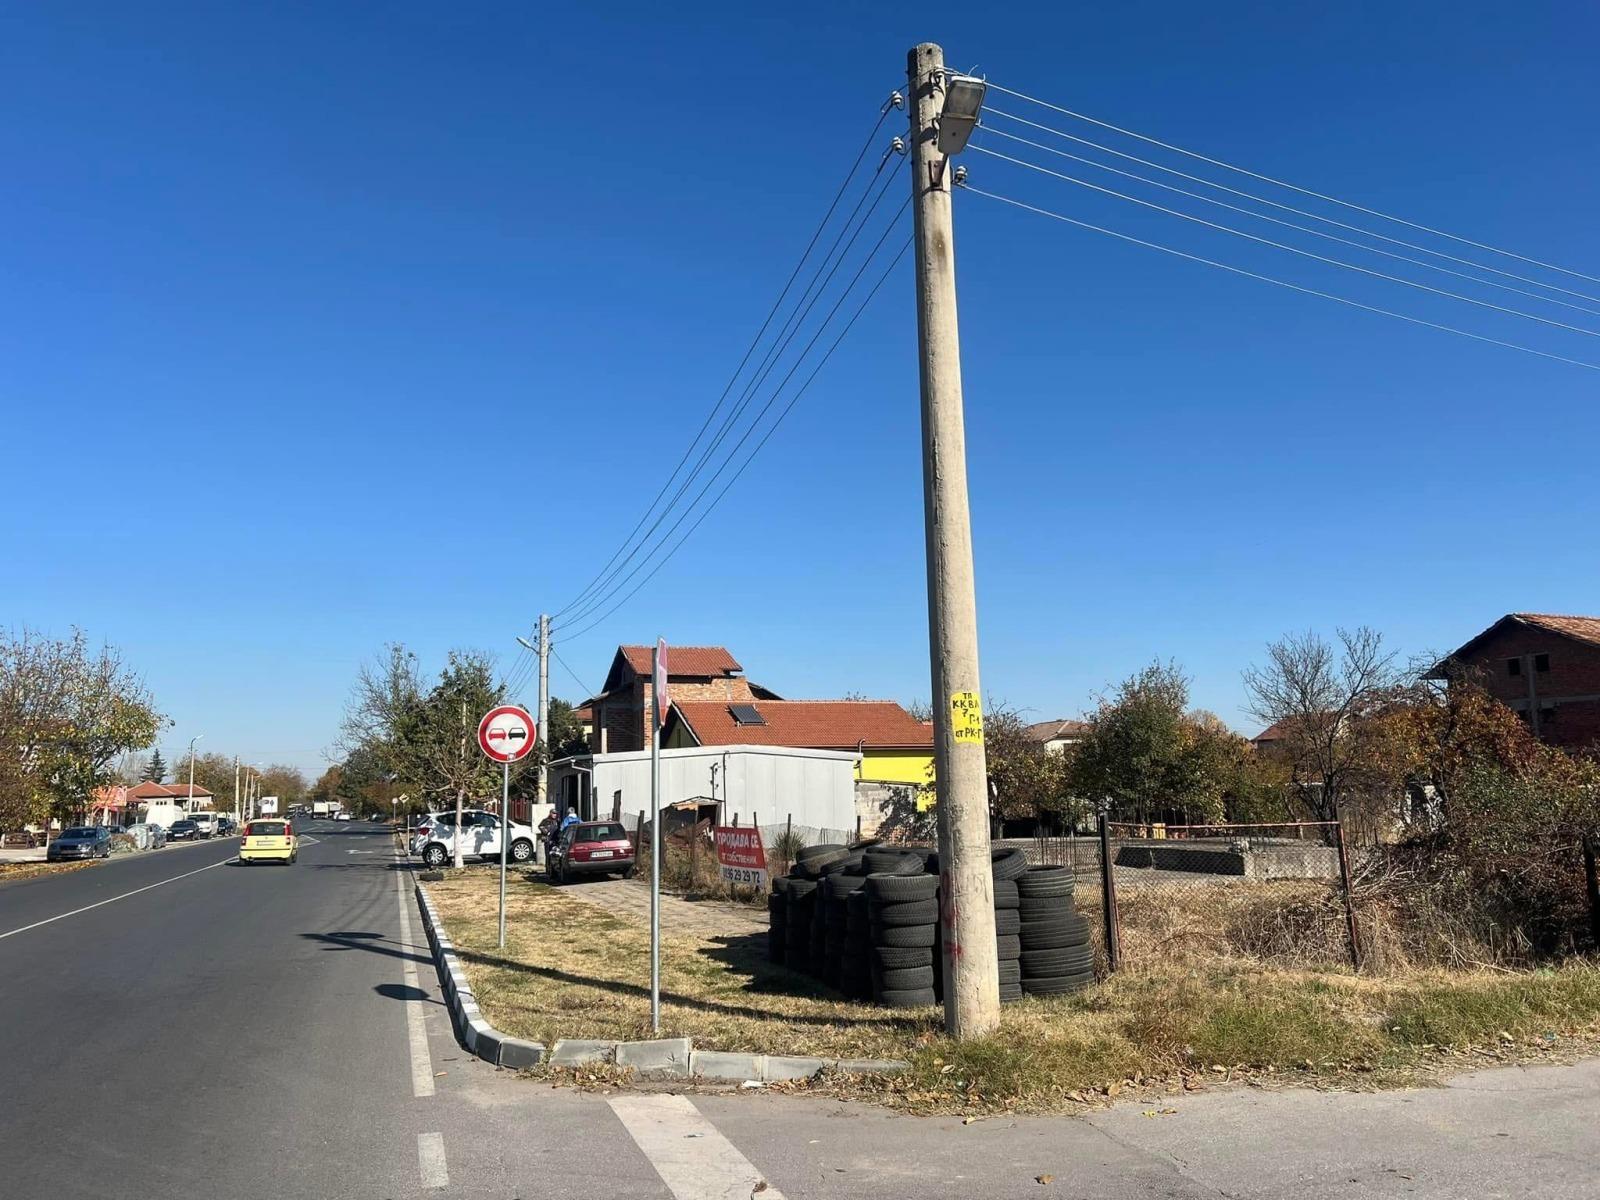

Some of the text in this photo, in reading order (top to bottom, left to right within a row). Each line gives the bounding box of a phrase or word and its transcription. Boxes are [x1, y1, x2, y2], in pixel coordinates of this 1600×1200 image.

[717, 832, 760, 849] ПРОДАВА СЕ
[751, 871, 761, 884] 72
